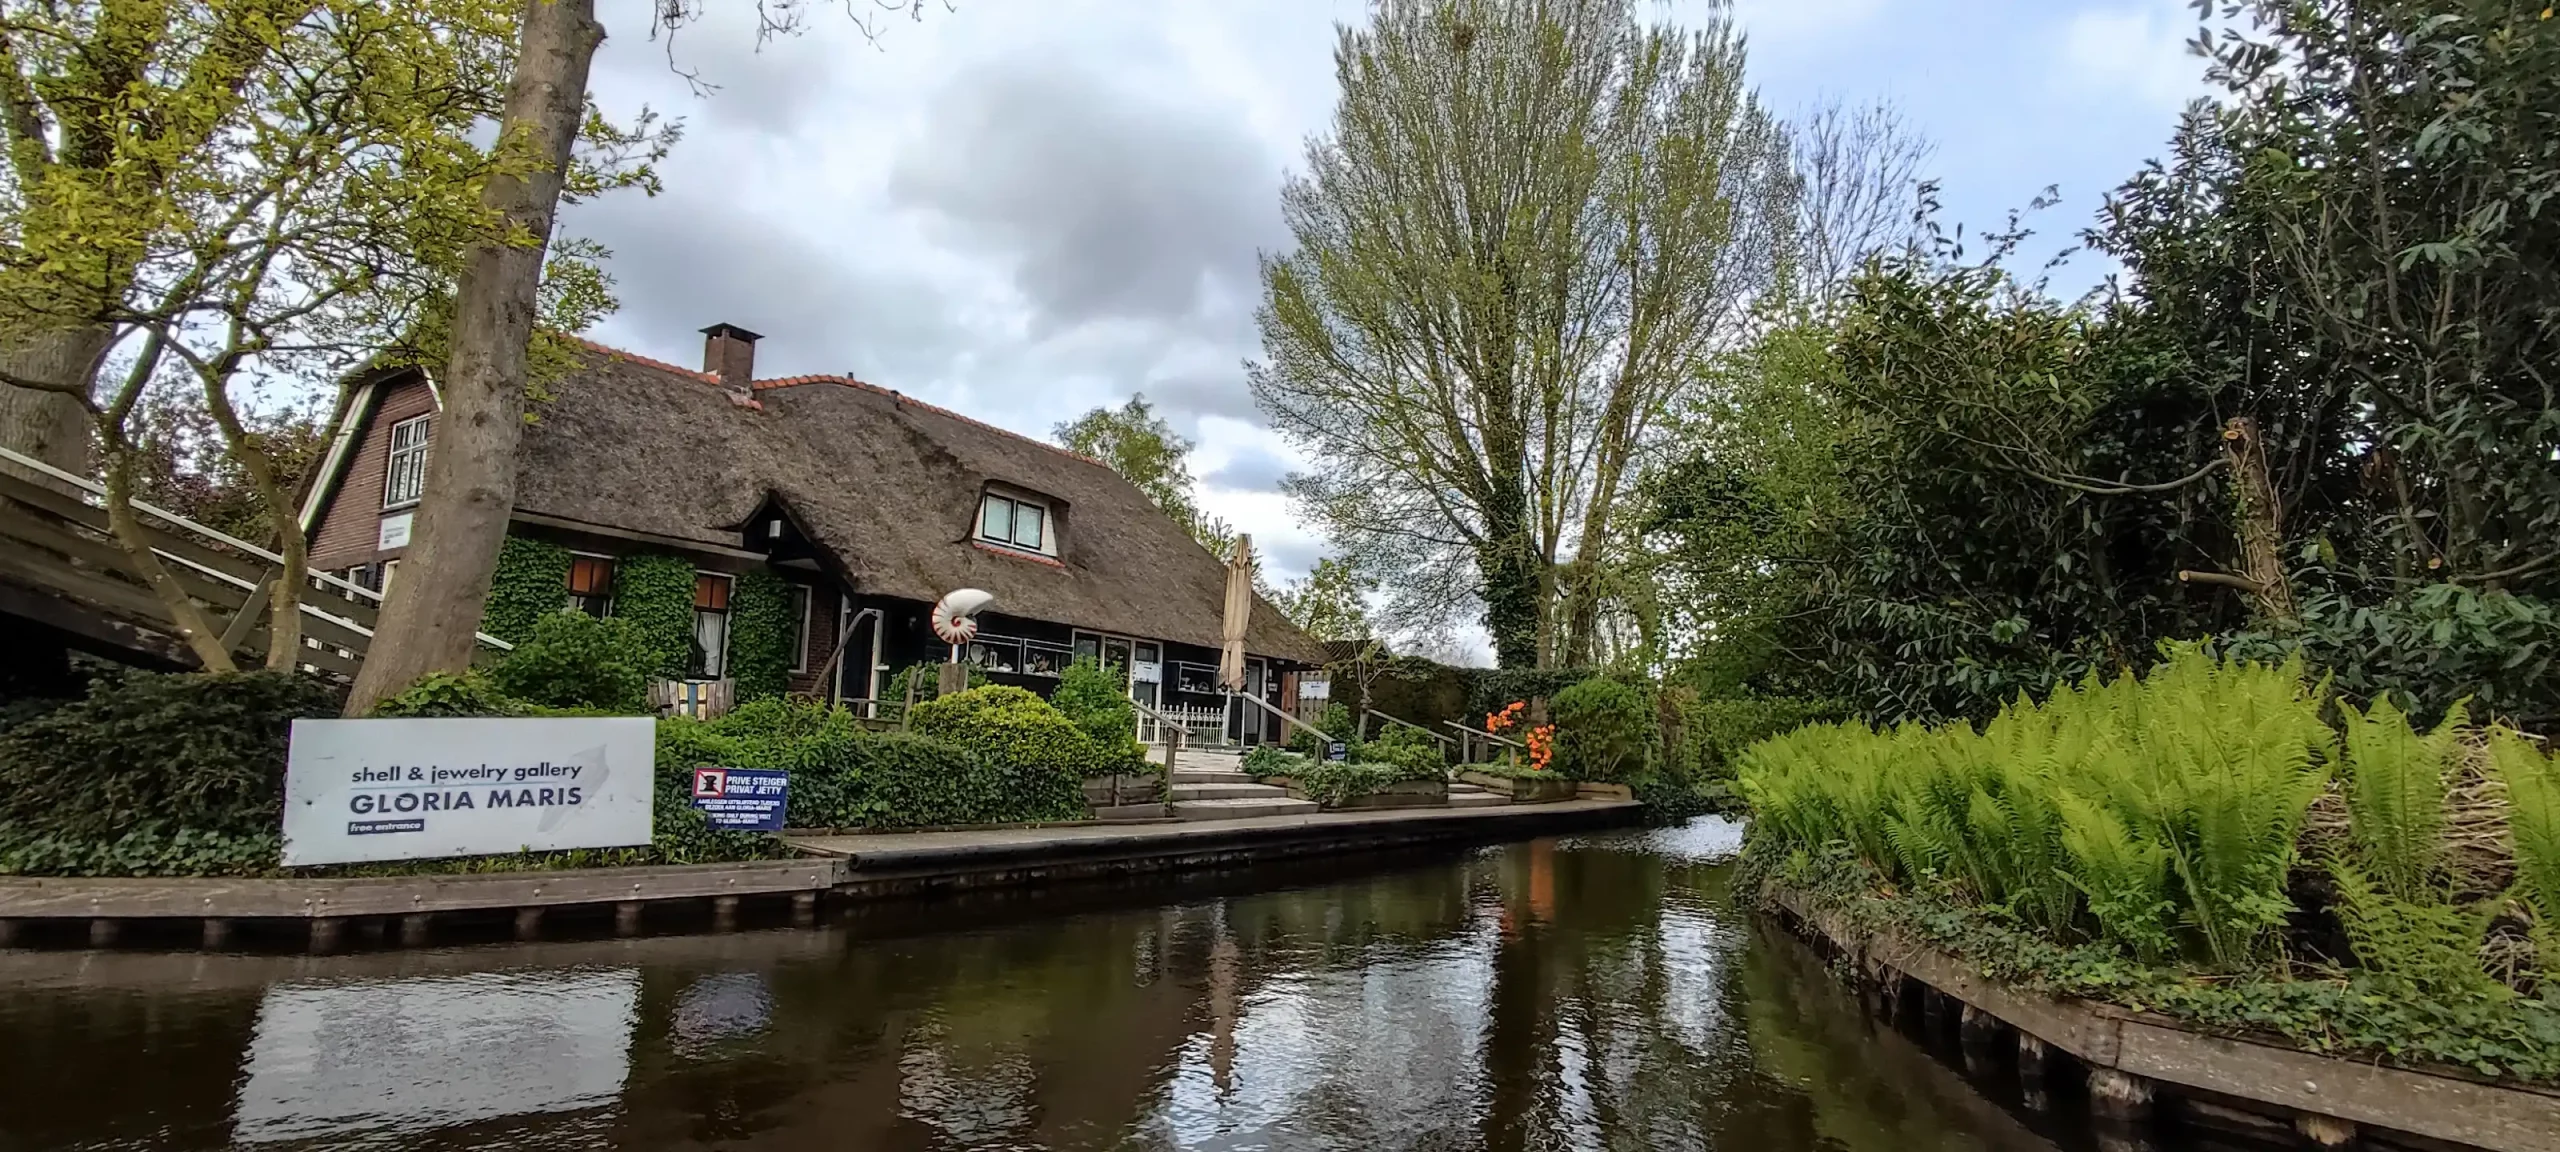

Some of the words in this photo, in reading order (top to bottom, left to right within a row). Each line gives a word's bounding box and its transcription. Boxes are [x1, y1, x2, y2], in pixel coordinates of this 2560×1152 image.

[352, 766, 401, 782] shell
[408, 767, 424, 781] &
[431, 763, 508, 784] jewelry
[514, 762, 583, 781] gallery
[726, 776, 752, 785] PRIVE
[752, 777, 787, 786] STEIGER
[725, 785, 755, 794] PRIVAT
[756, 786, 782, 795] JETTY
[350, 790, 475, 814] GLORIA
[487, 787, 582, 809] MARIS
[350, 823, 373, 832] free
[375, 822, 421, 831] entrance
